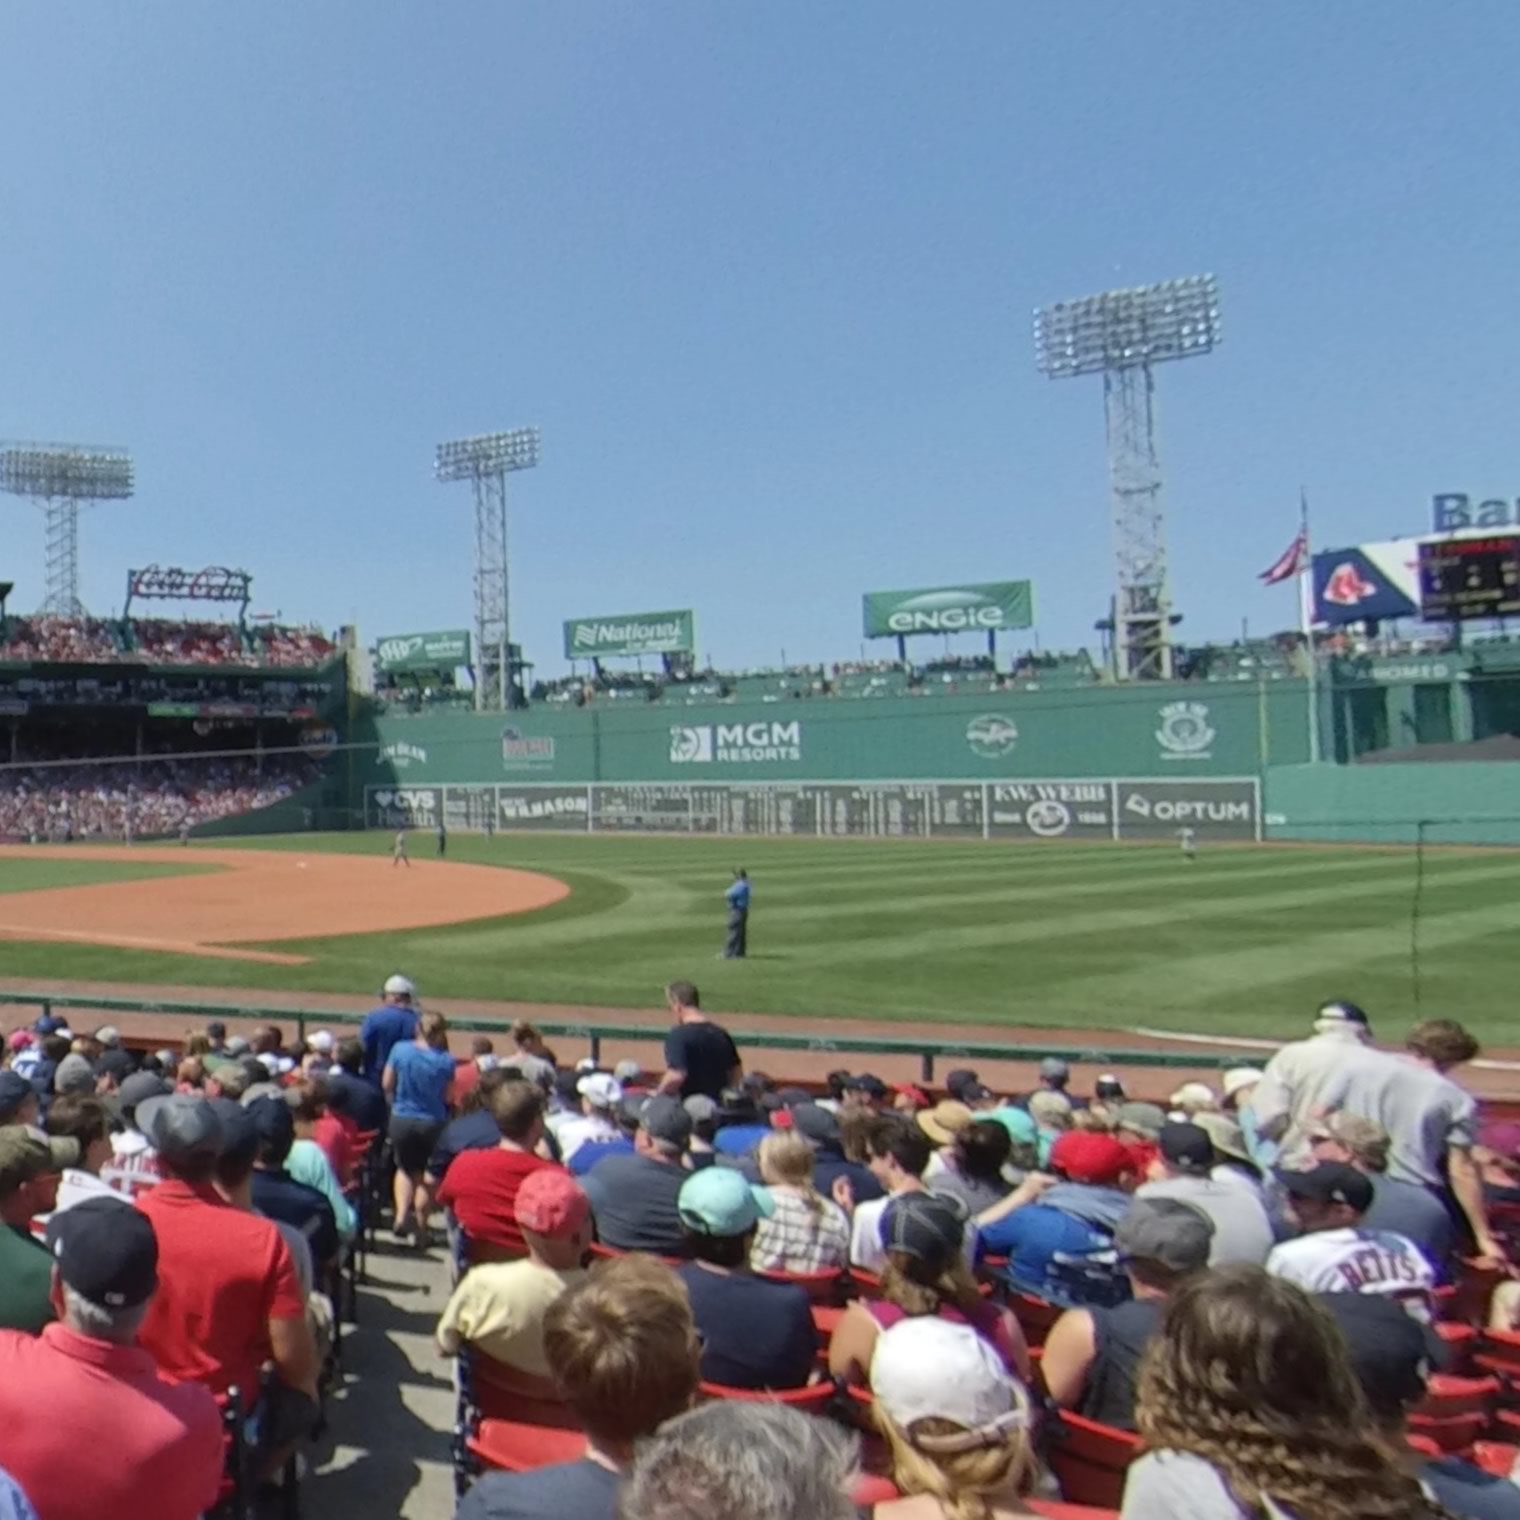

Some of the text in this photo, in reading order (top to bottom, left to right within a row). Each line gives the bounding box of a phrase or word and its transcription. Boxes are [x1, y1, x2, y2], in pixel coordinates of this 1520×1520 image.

[1433, 493, 1520, 532] Ba
[597, 618, 682, 642] National
[717, 720, 800, 747] MGM
[717, 747, 800, 762] RESORTS
[394, 791, 434, 809] CVS
[1153, 801, 1249, 820] OPTUM
[1337, 1248, 1417, 1292] BETTS
